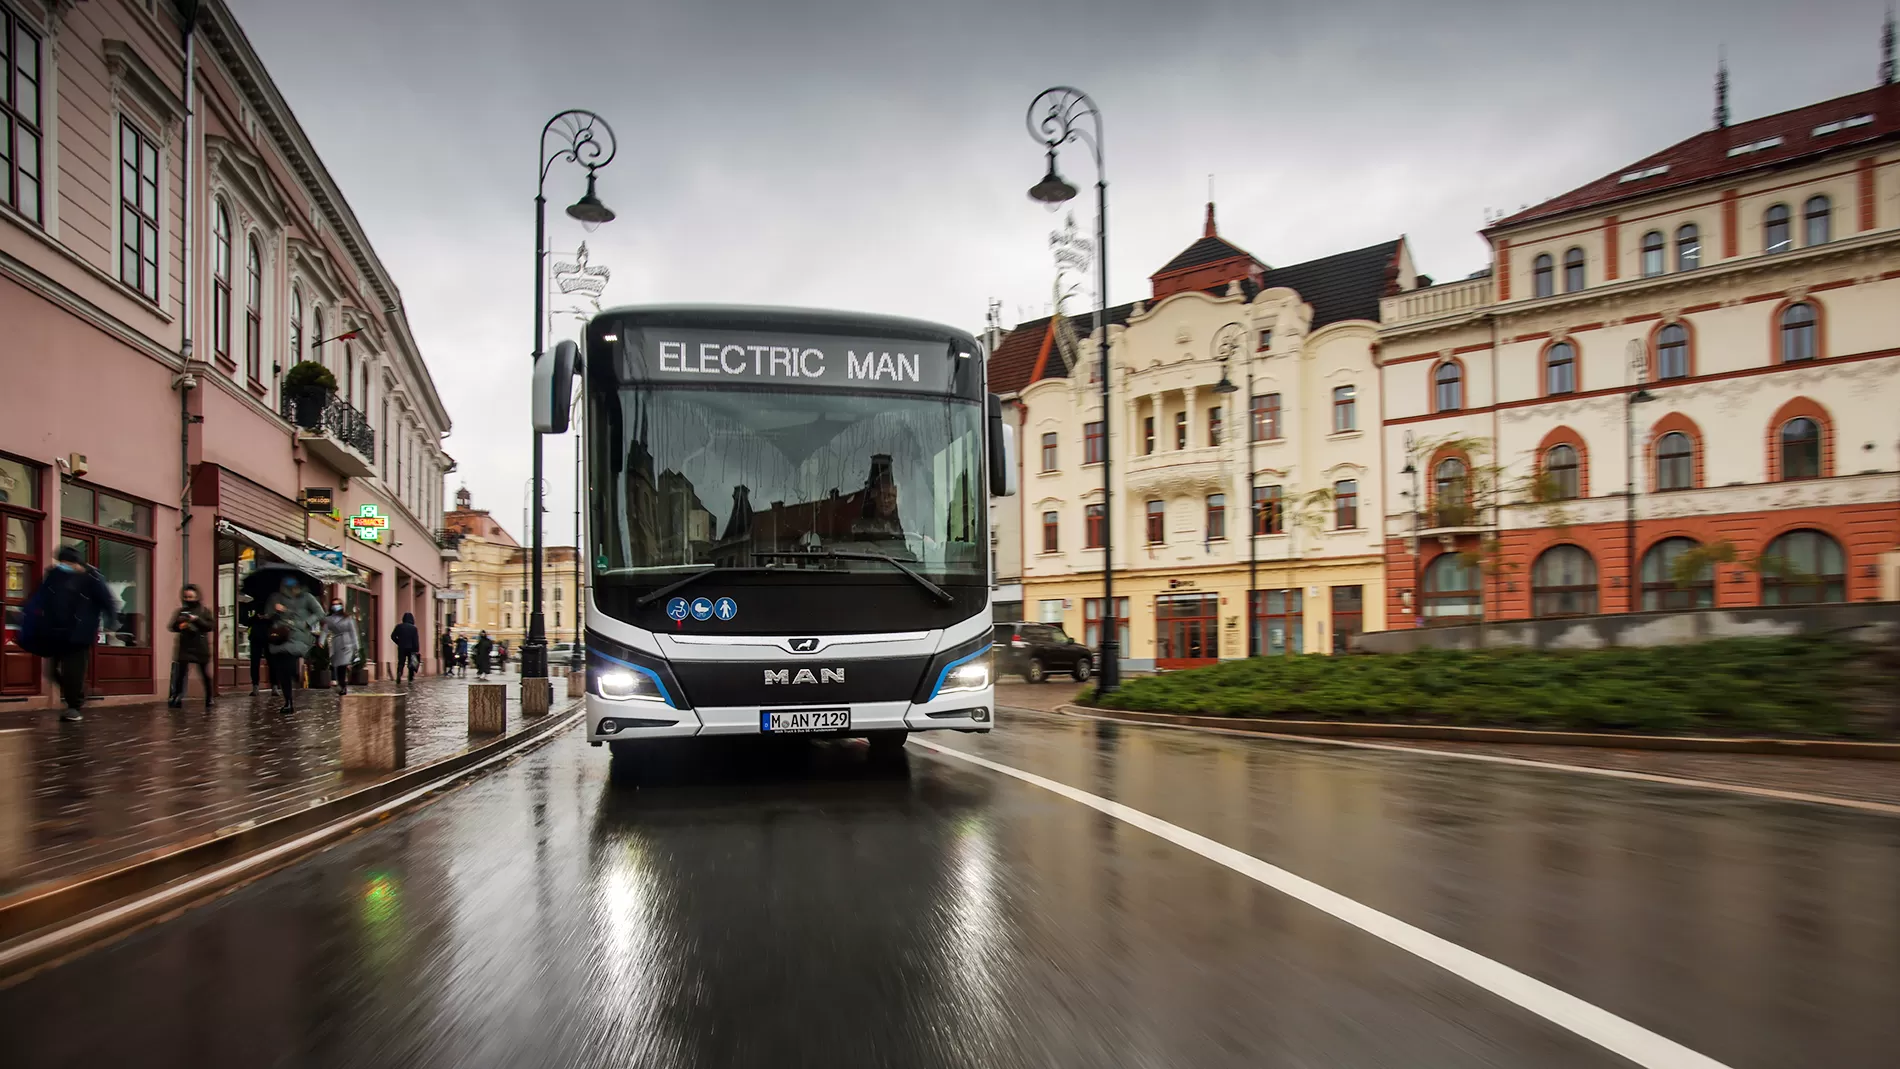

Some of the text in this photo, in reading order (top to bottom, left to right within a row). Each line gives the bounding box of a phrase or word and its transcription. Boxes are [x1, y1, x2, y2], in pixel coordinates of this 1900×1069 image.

[659, 341, 920, 382] ELECTRIC MAN
[353, 517, 385, 527] FARMACIE
[764, 667, 845, 685] MAN
[771, 712, 848, 728] M AN 7129
